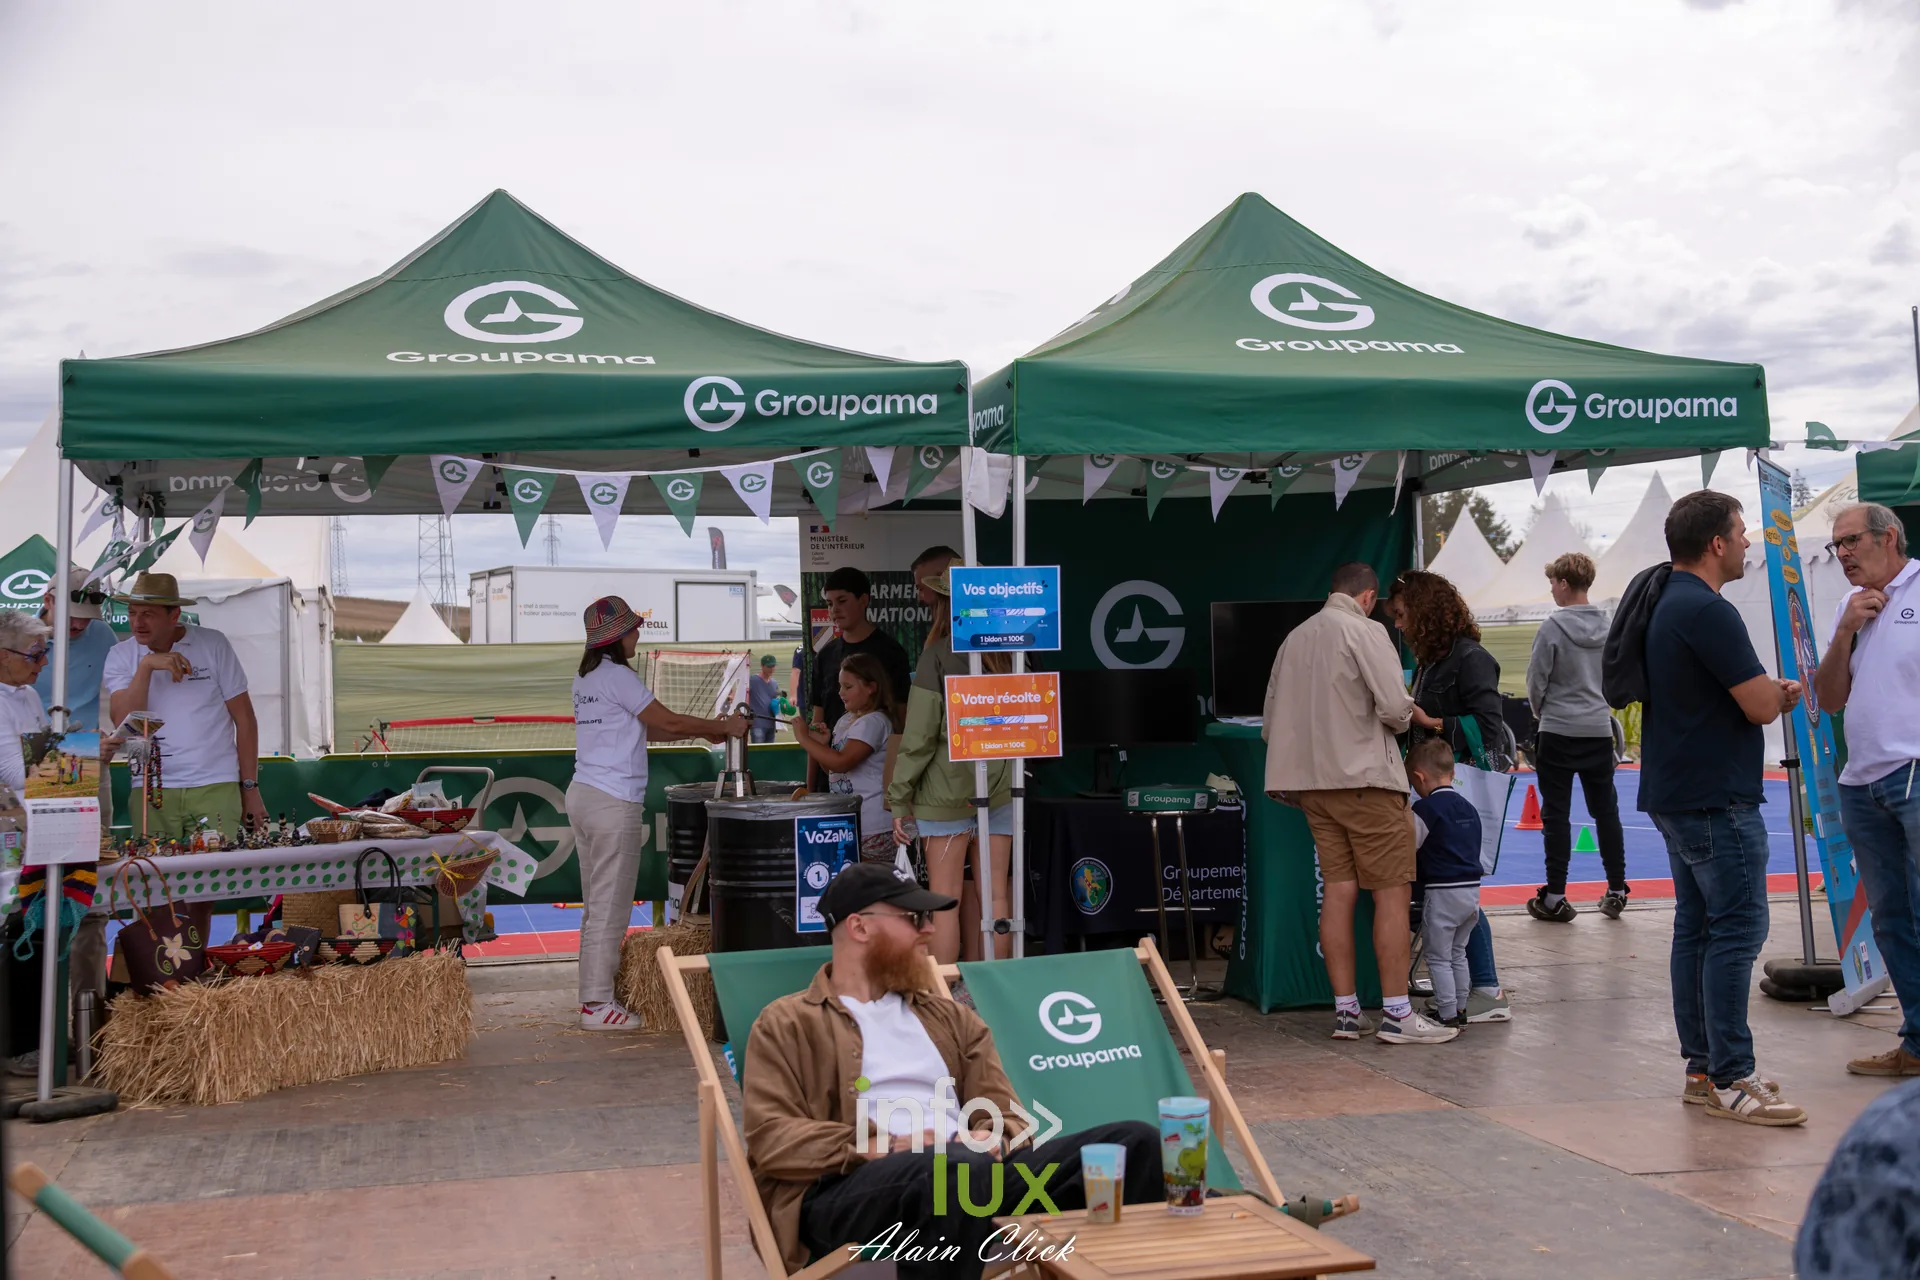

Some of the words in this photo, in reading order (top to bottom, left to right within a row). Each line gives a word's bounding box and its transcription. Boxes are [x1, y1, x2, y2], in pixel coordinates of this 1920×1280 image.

[1235, 338, 1465, 353] Groupama
[386, 351, 656, 364] Groupama
[754, 389, 937, 421] Groupama
[1584, 393, 1738, 423] Groupama
[962, 583, 986, 595] Vos
[988, 581, 1044, 598] objectifs
[633, 609, 653, 620] hef
[866, 607, 933, 622] NATION
[984, 635, 1002, 643] bidon
[961, 693, 994, 705] Votre
[997, 691, 1041, 703] récolte
[1144, 794, 1191, 804] Groupama
[805, 828, 854, 844] VoZaMa
[1029, 1044, 1142, 1071] Groupama
